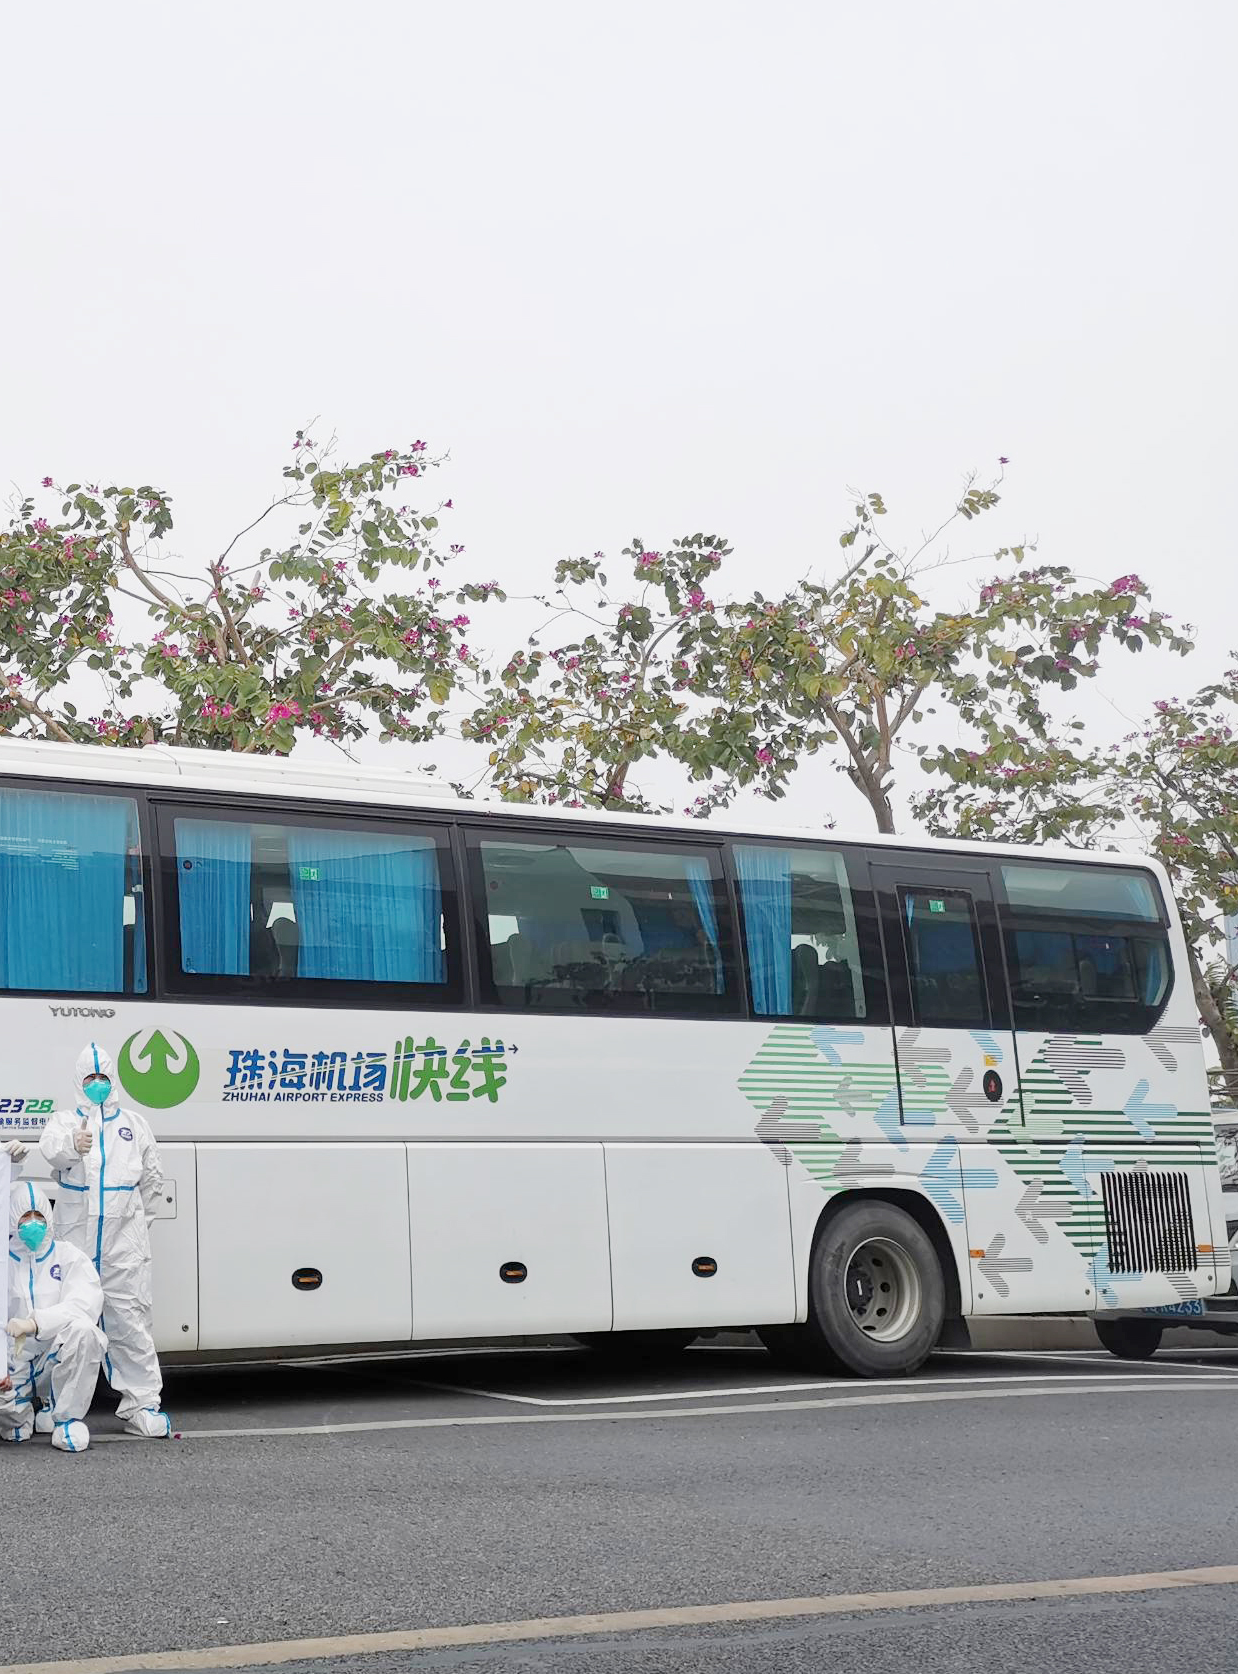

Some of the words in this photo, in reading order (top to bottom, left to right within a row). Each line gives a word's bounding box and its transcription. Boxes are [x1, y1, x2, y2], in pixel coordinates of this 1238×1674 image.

[48, 1005, 116, 1018] YUTONG
[223, 1036, 508, 1103] 珠海机场快线
[222, 1092, 270, 1102] ZHUHAI
[273, 1092, 327, 1102] AIRPORT
[329, 1093, 384, 1102] EXPRESS
